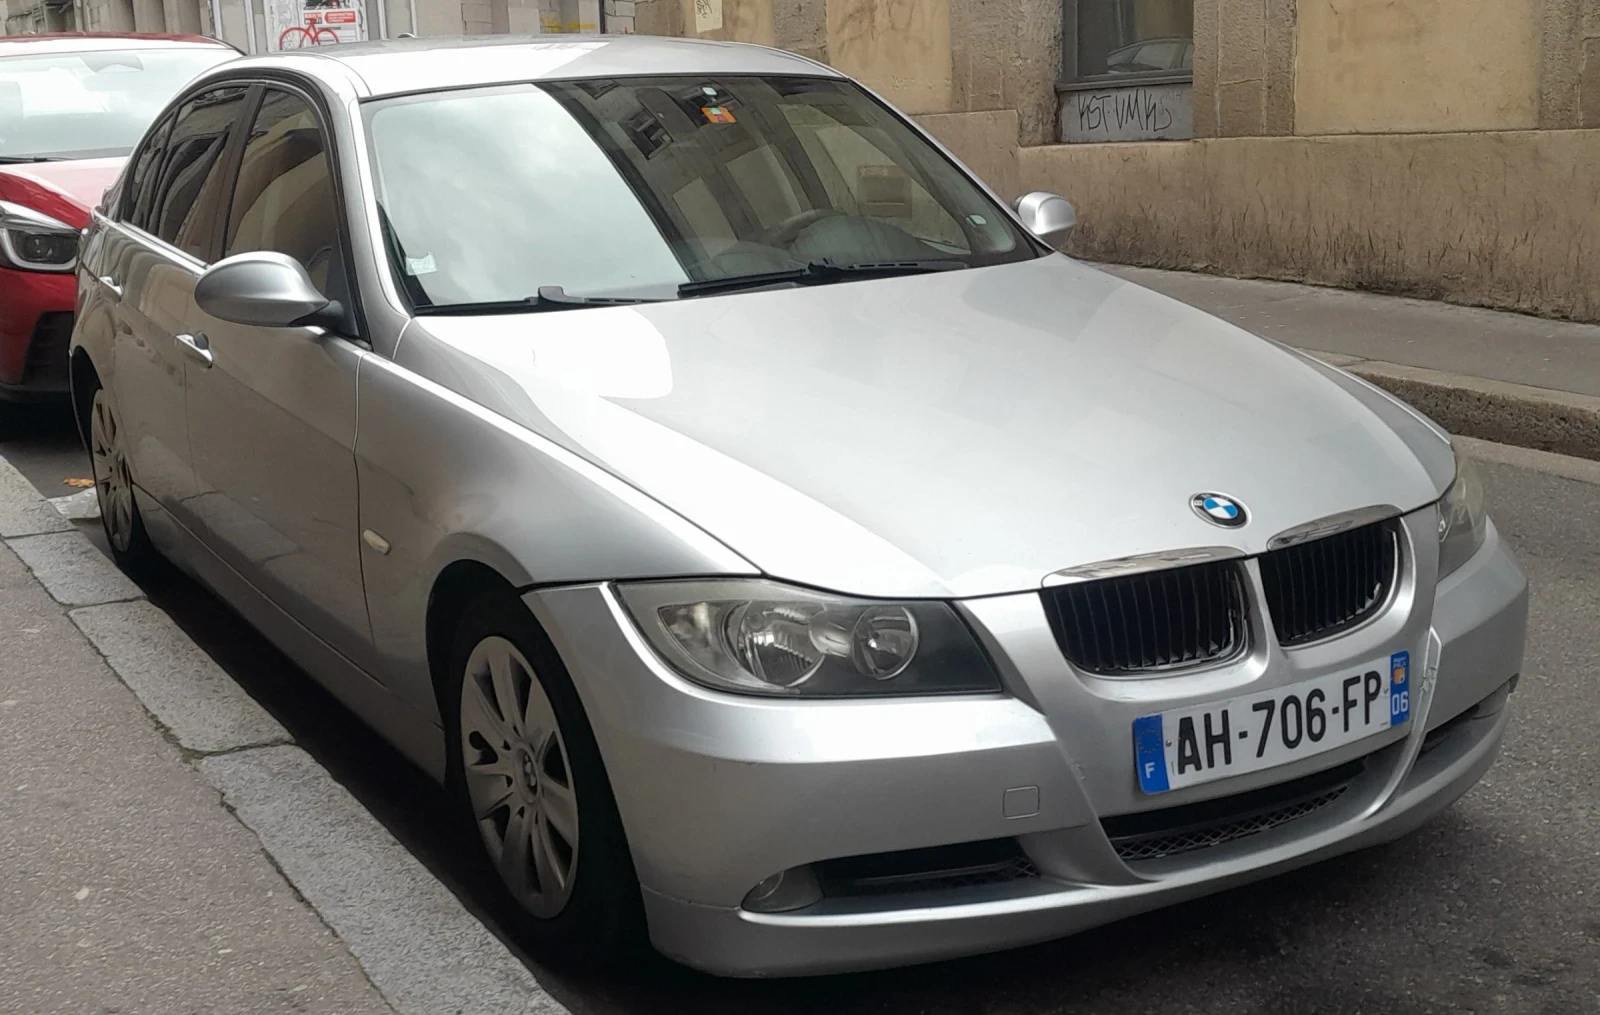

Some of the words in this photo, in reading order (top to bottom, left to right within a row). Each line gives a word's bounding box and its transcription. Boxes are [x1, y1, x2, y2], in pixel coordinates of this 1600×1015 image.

[1391, 690, 1409, 716] 06
[1177, 670, 1381, 775] AH-706-FP
[1144, 761, 1155, 779] F
